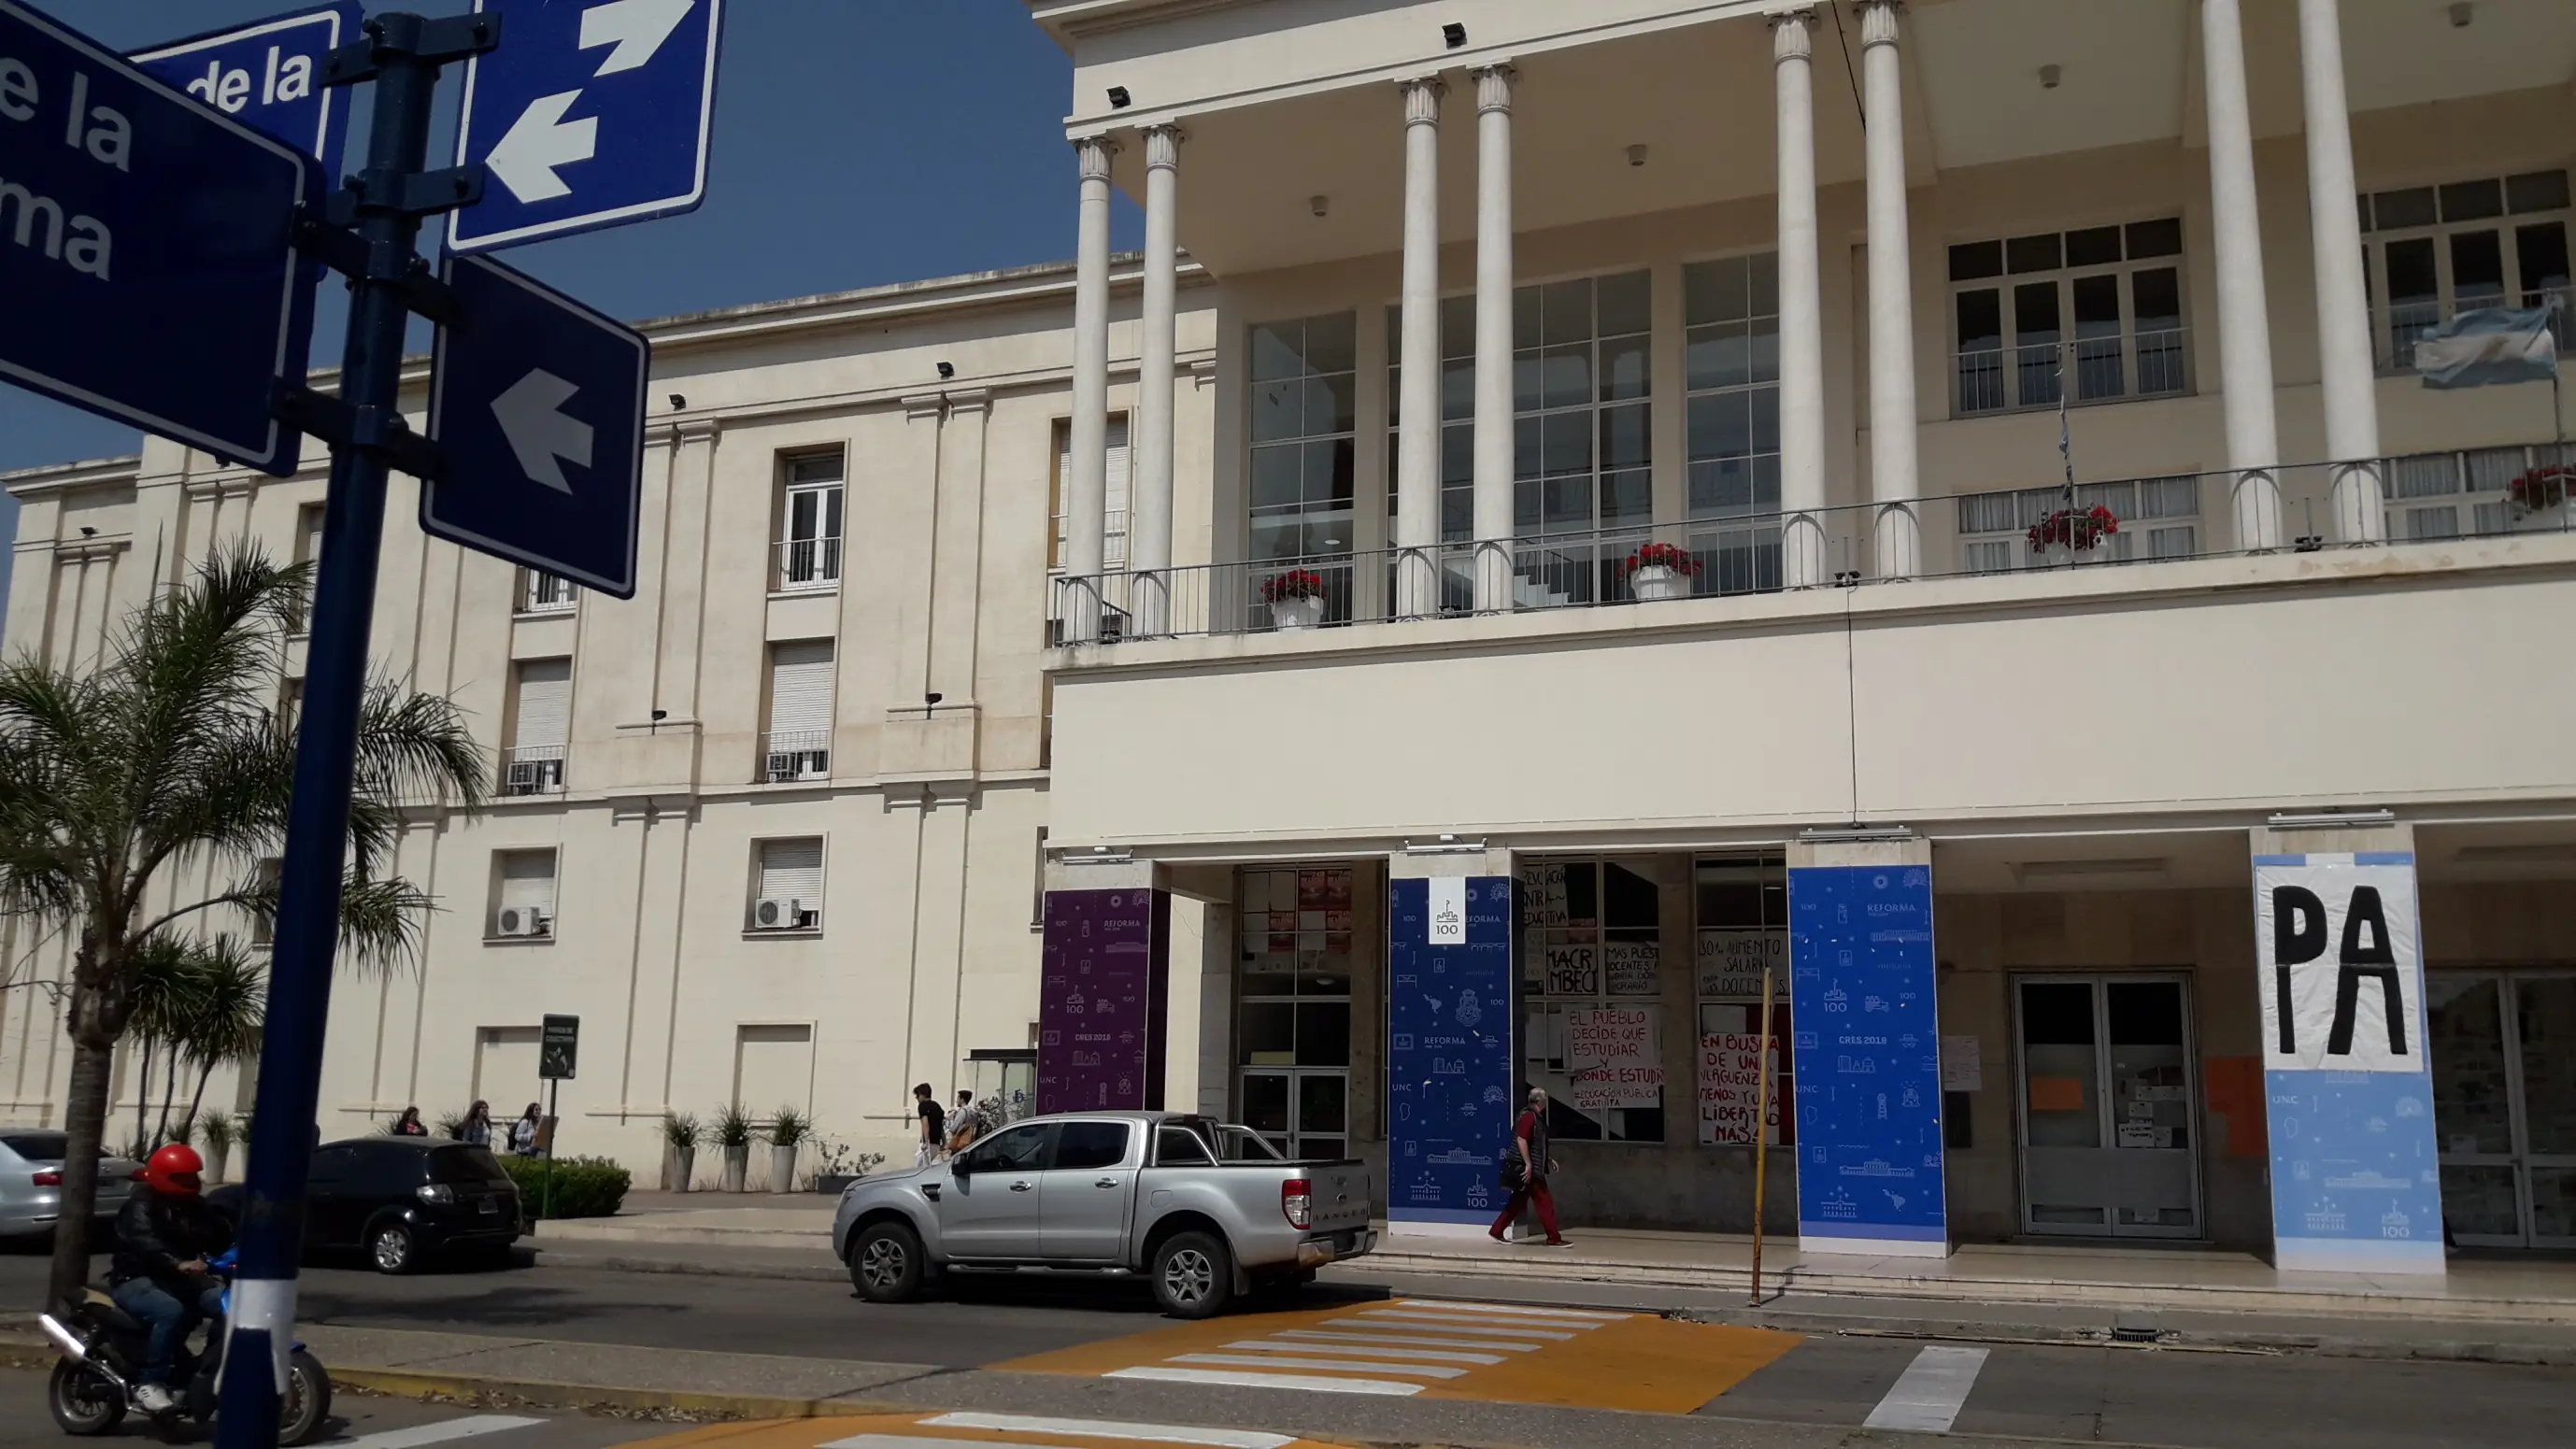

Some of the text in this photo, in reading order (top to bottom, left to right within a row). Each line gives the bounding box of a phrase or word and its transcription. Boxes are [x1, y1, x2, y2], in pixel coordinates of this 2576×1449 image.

[263, 46, 311, 105] la
[0, 57, 132, 173] e la
[0, 178, 111, 281] ma
[1867, 902, 1915, 912] REFORMA
[1436, 924, 1459, 934] 100
[1608, 960, 1650, 971] OCENTES
[1066, 1004, 1084, 1014] 100
[1824, 1002, 1847, 1013] 100
[1570, 1010, 1645, 1026] EL PUEBLO
[1622, 1027, 1646, 1041] QUE
[1424, 1036, 1466, 1044] REFORMA
[1701, 1034, 1779, 1053] EN BUSA
[1839, 1036, 1887, 1044] CRES 2018
[1707, 1052, 1726, 1067] DE
[1796, 1085, 1818, 1093] UNC
[2272, 1095, 2298, 1104] UNC
[1467, 1197, 1487, 1207] 100
[2382, 1226, 2410, 1238] 100
